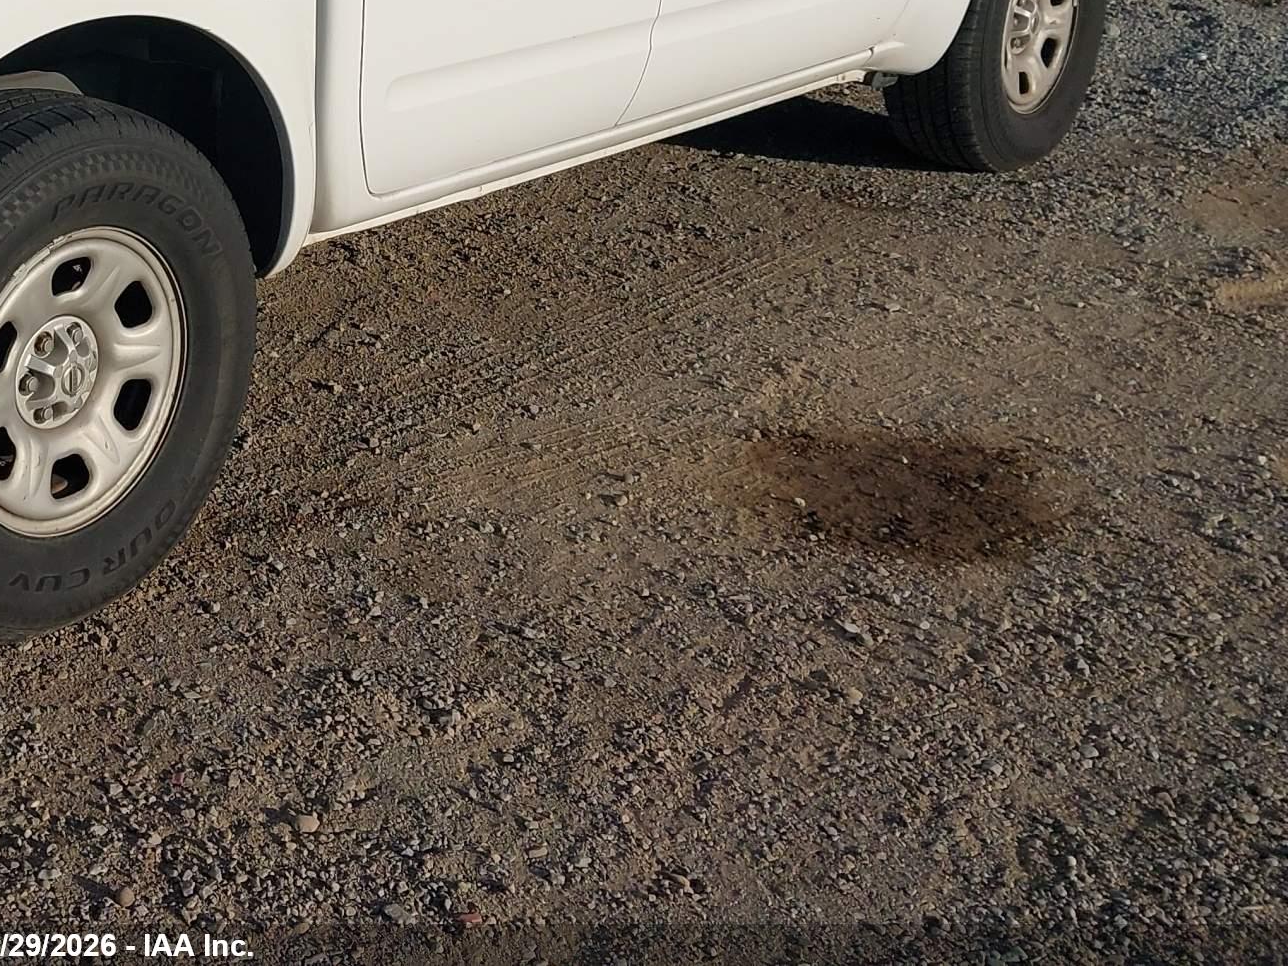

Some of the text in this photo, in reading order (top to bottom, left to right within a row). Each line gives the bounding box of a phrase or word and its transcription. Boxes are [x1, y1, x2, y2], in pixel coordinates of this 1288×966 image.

[49, 181, 224, 256] PARAGON
[7, 488, 186, 592] OUR CUV
